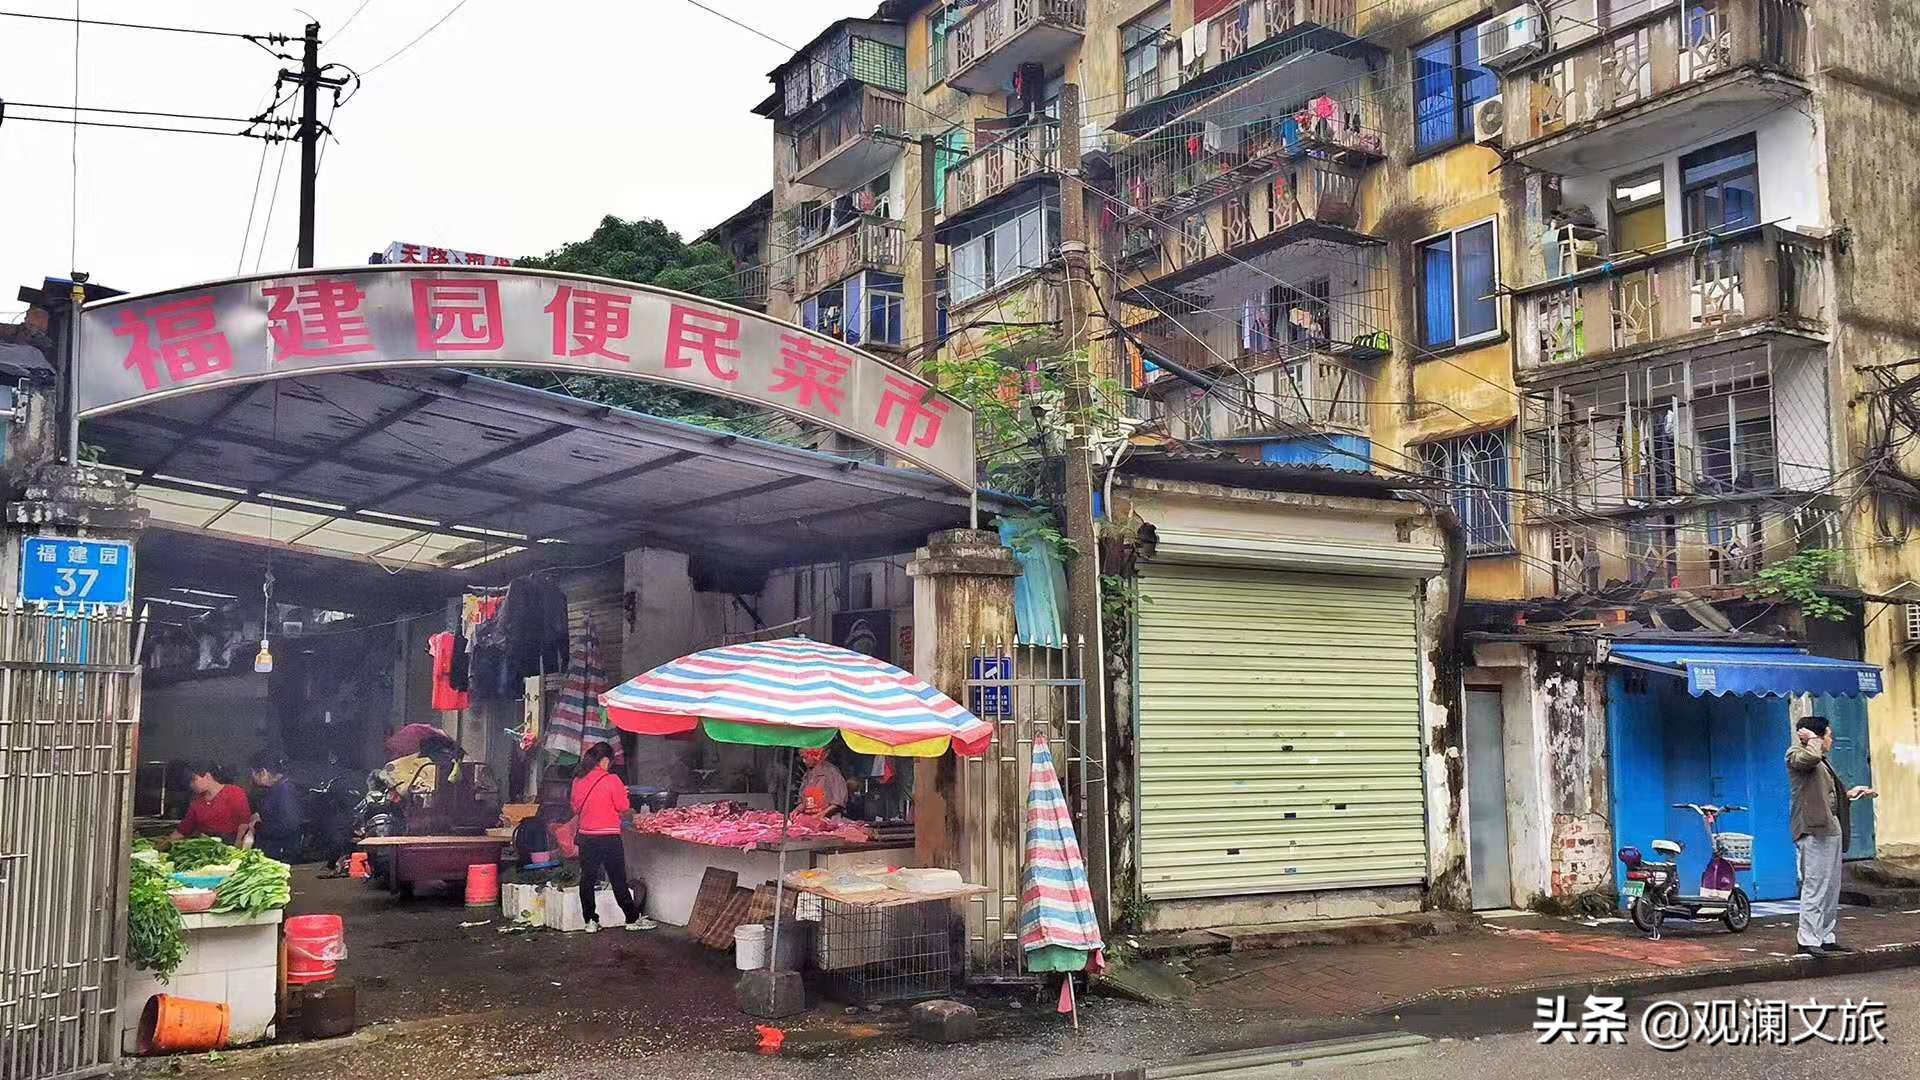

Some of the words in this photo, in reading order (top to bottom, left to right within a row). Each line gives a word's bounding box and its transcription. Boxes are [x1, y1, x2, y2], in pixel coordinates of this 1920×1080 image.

[112, 280, 950, 447] 福建园便民菜市
[37, 544, 119, 565] 福建园
[54, 568, 99, 598] 37
